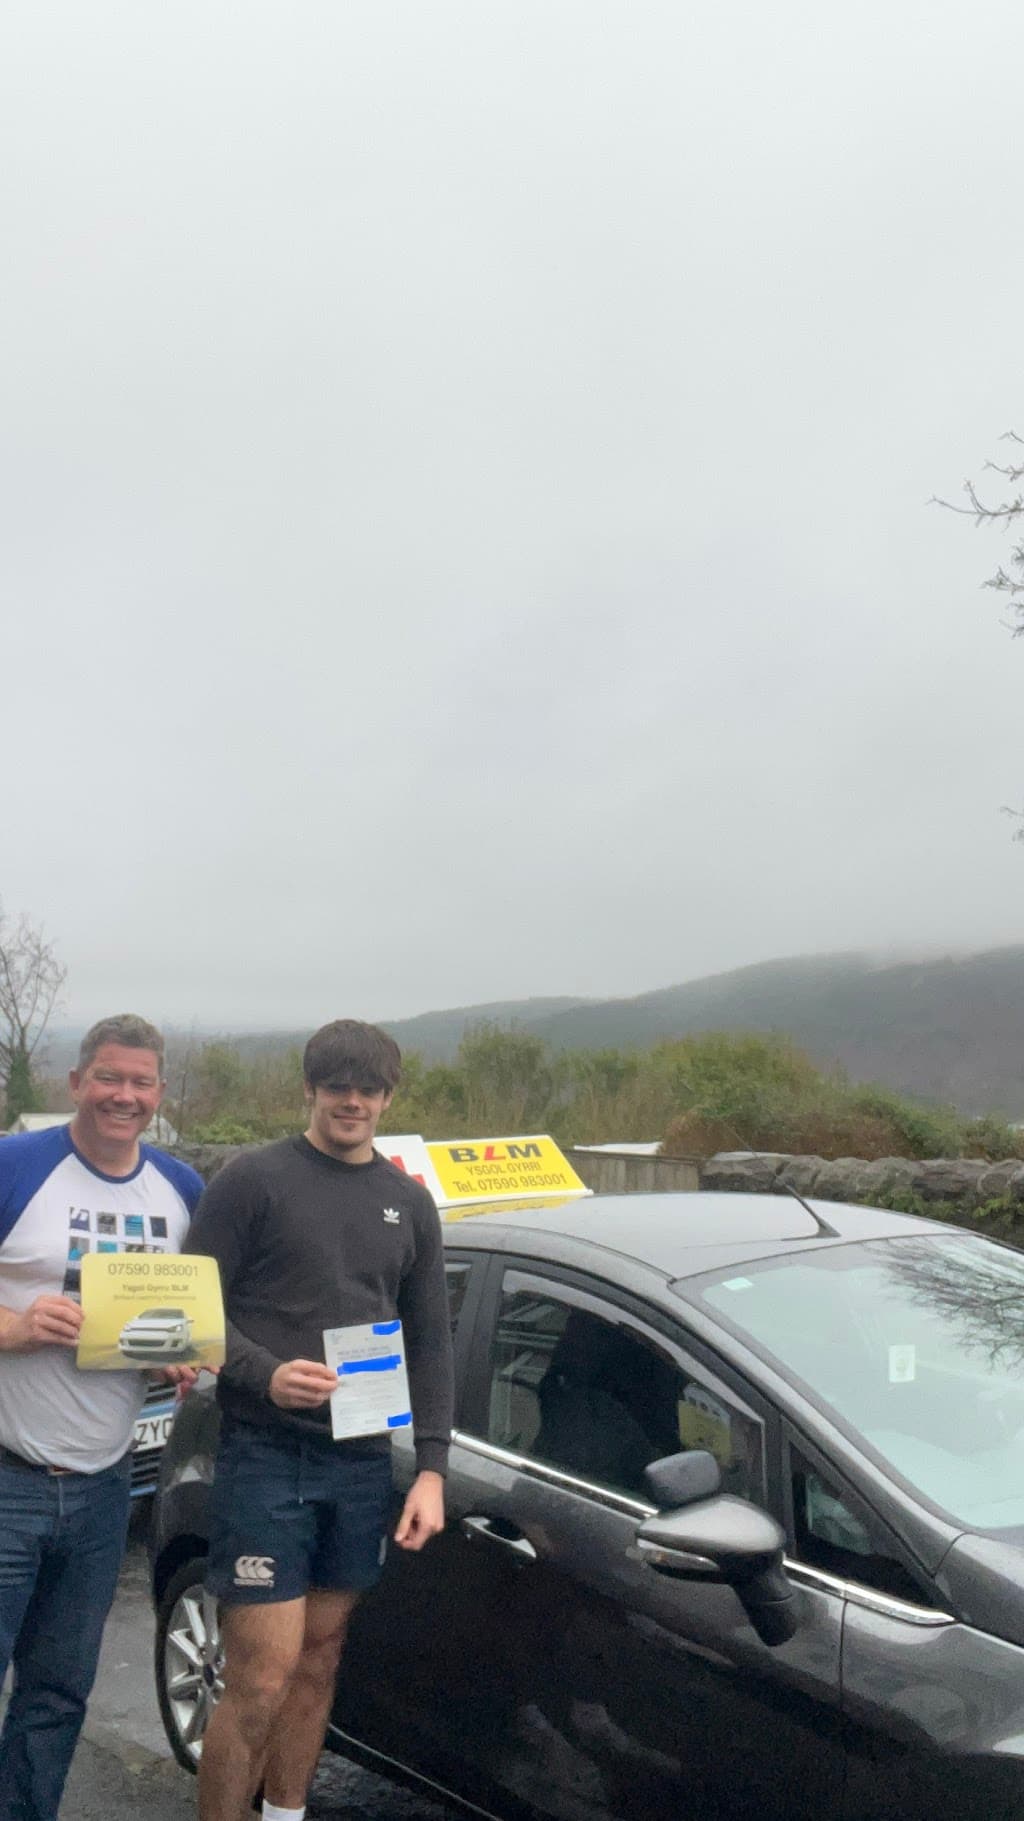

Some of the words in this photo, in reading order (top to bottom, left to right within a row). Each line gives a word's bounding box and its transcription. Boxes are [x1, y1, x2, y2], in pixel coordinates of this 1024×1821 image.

[449, 1143, 543, 1163] BLM
[465, 1163, 506, 1176] YSGOL
[478, 1177, 518, 1191] 07590
[519, 1173, 568, 1188] 983001
[108, 1263, 151, 1276] 07590
[153, 1263, 199, 1277] 983001
